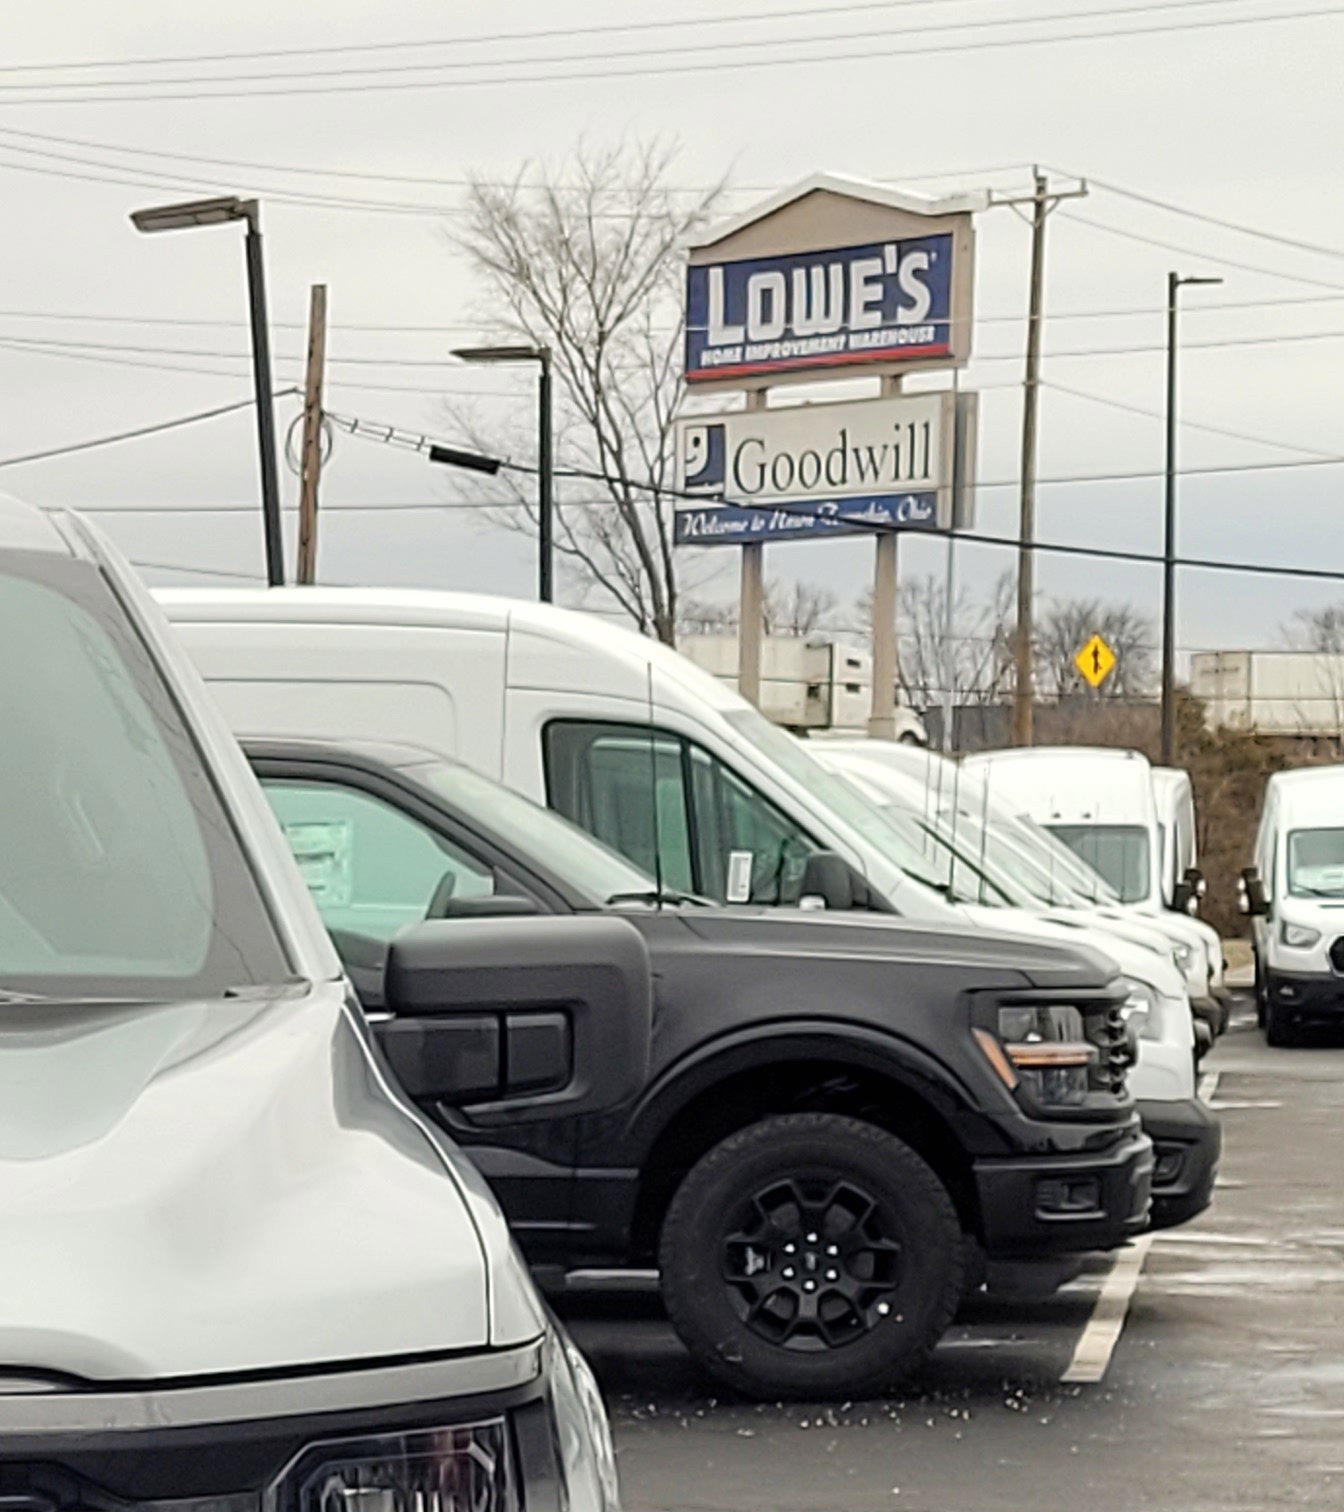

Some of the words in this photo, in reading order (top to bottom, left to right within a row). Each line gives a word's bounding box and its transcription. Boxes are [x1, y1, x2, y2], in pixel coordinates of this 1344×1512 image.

[707, 245, 932, 346] LOWE'S
[701, 346, 742, 366] HOME
[745, 334, 846, 361] IMPROVEMENT
[848, 326, 936, 350] WAREHOUSE
[733, 421, 931, 495] Goodwill
[683, 511, 748, 536] Welcome
